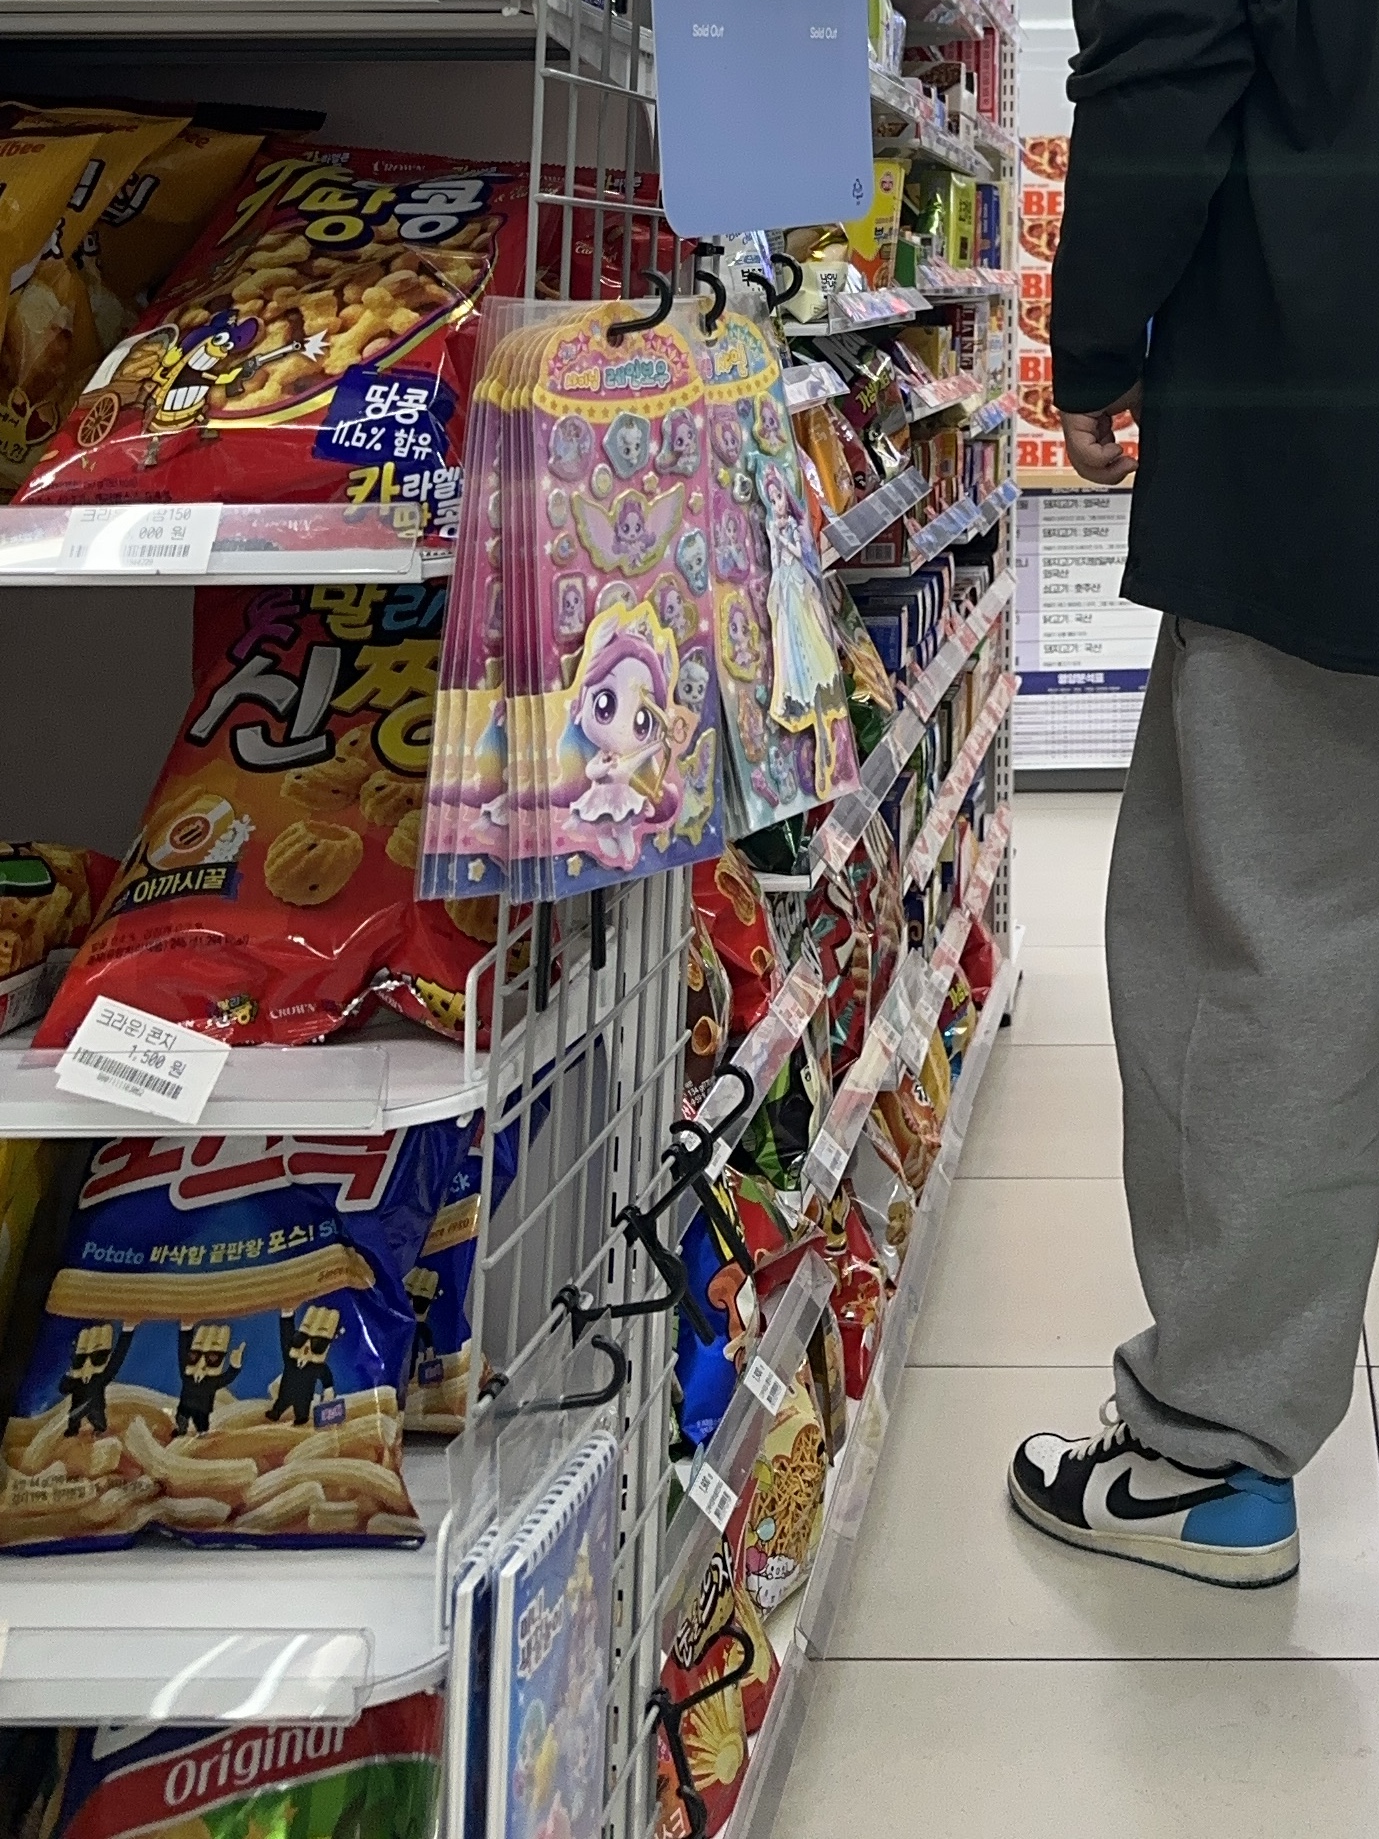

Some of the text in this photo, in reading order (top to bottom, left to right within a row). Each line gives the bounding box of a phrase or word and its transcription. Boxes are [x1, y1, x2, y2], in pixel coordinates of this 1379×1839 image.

[692, 24, 725, 38] Sold Out
[809, 27, 838, 40] Sold Out
[297, 178, 486, 244] 땅콩
[364, 384, 429, 424] 땅콩
[331, 422, 433, 460] 11.6% 함유
[344, 461, 462, 516] 카라멜
[132, 867, 228, 904] 아까시꿀
[269, 1002, 317, 1021] CROWN
[127, 1044, 188, 1080] 1,500 원
[82, 1241, 145, 1265] Potato
[267, 1224, 315, 1253] 포스!
[165, 1724, 346, 1808] Original
